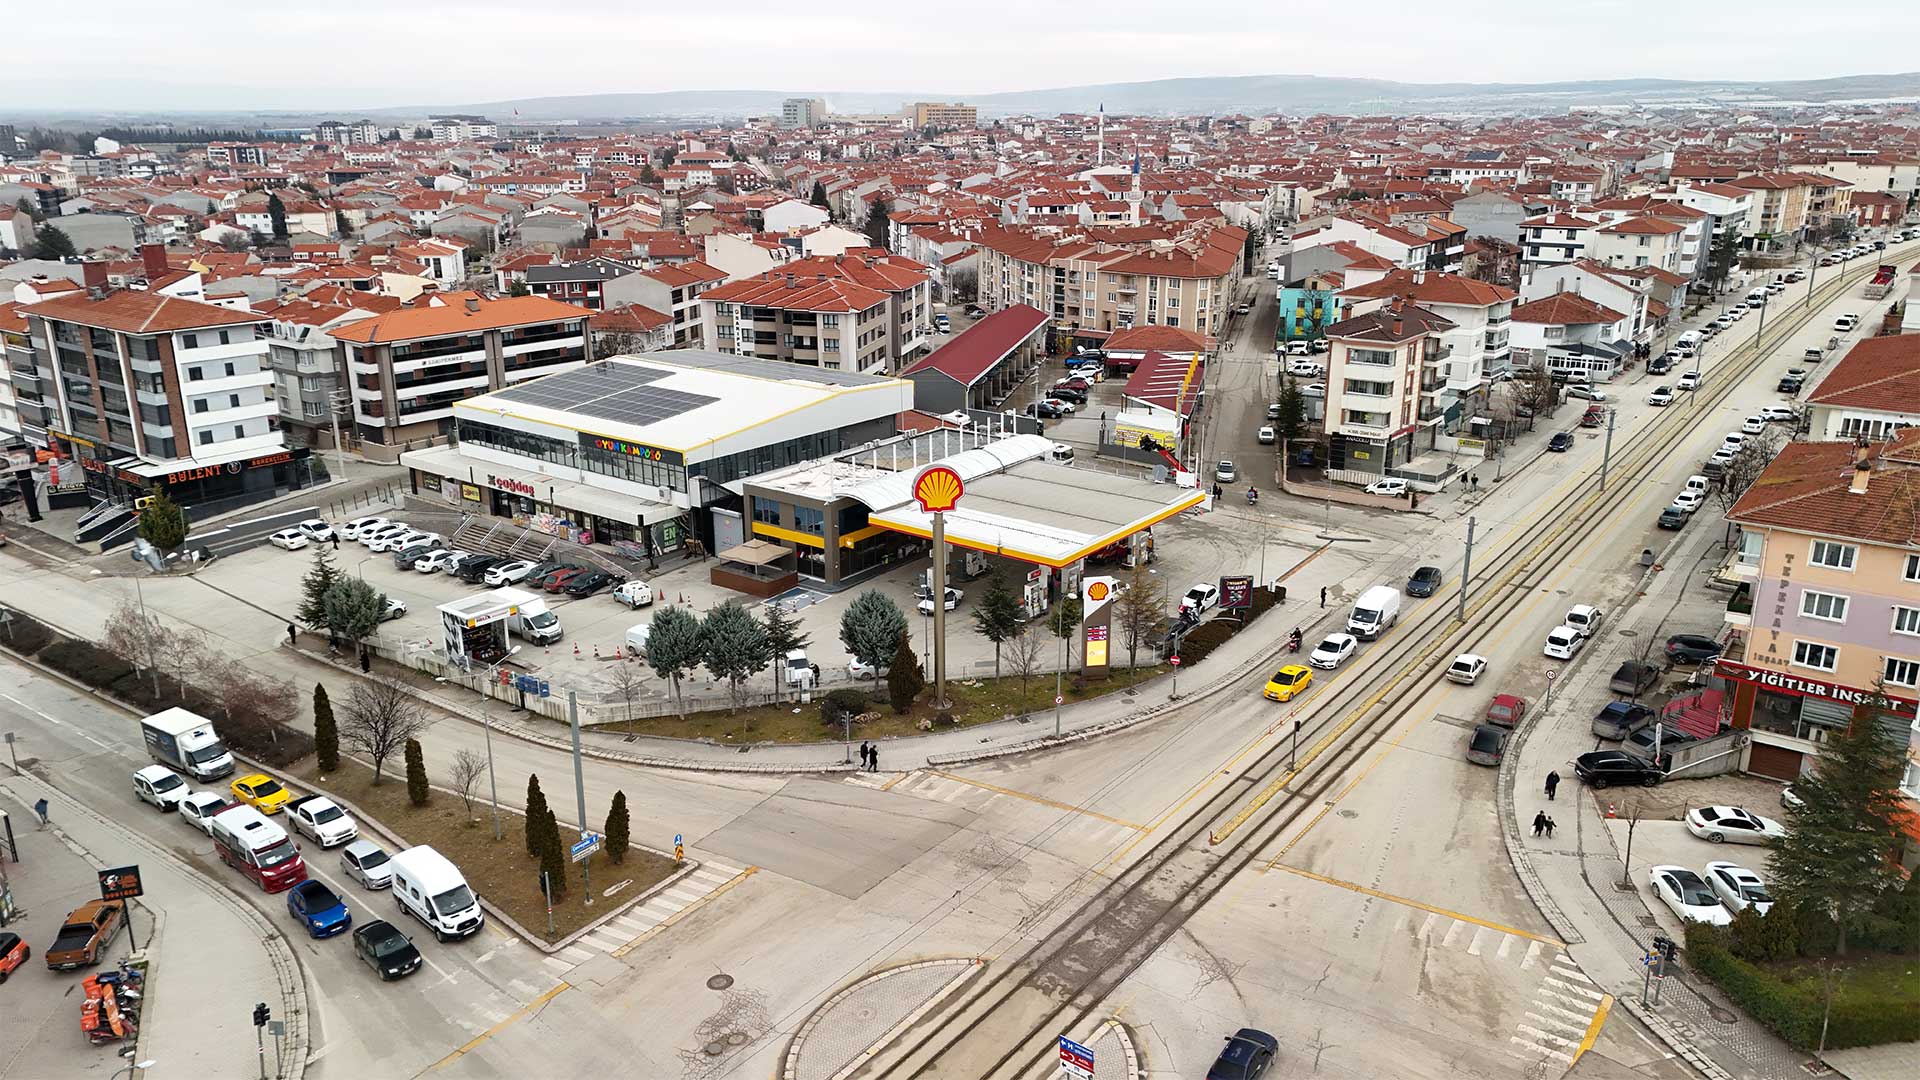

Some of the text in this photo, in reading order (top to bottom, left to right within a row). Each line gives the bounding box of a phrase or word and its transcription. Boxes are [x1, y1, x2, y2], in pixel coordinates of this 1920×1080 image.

[595, 439, 620, 453] OYUN
[168, 464, 221, 485] BÜLENT
[496, 478, 535, 498] çağdaş
[663, 526, 677, 541] EN
[1768, 553, 1795, 653] TEPEKAYA
[1748, 669, 1826, 696] YİĞİTLER
